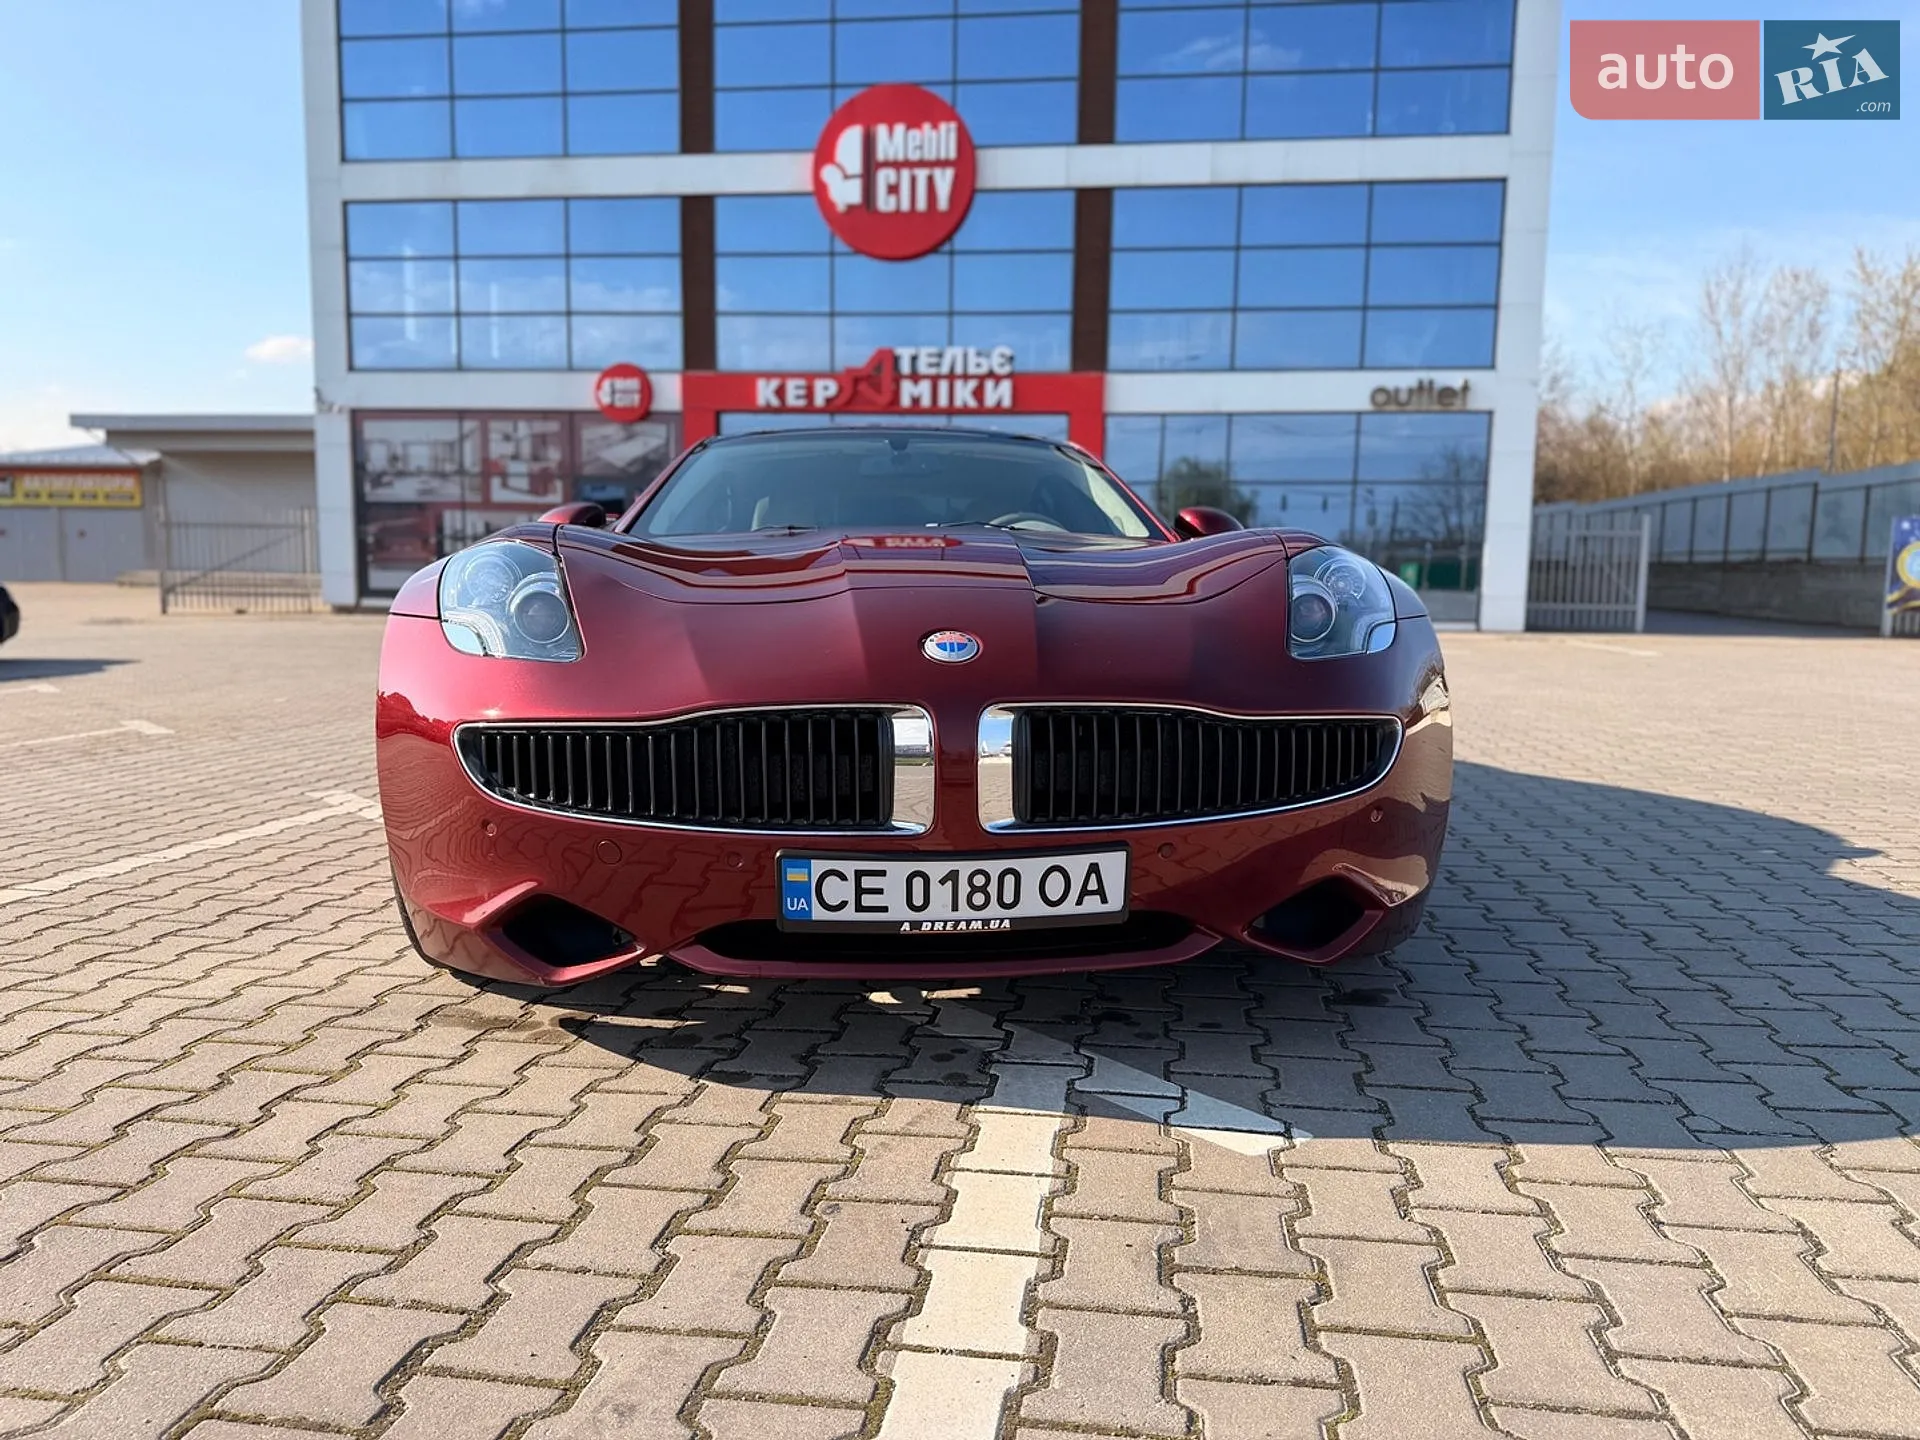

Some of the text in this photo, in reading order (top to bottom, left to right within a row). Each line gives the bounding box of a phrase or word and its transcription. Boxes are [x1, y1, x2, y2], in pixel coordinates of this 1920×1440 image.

[876, 121, 959, 162] Mebli
[876, 167, 956, 213] CITY
[1370, 378, 1471, 410] outlet
[786, 897, 809, 911] UA
[814, 862, 1109, 913] CE 0180 OA
